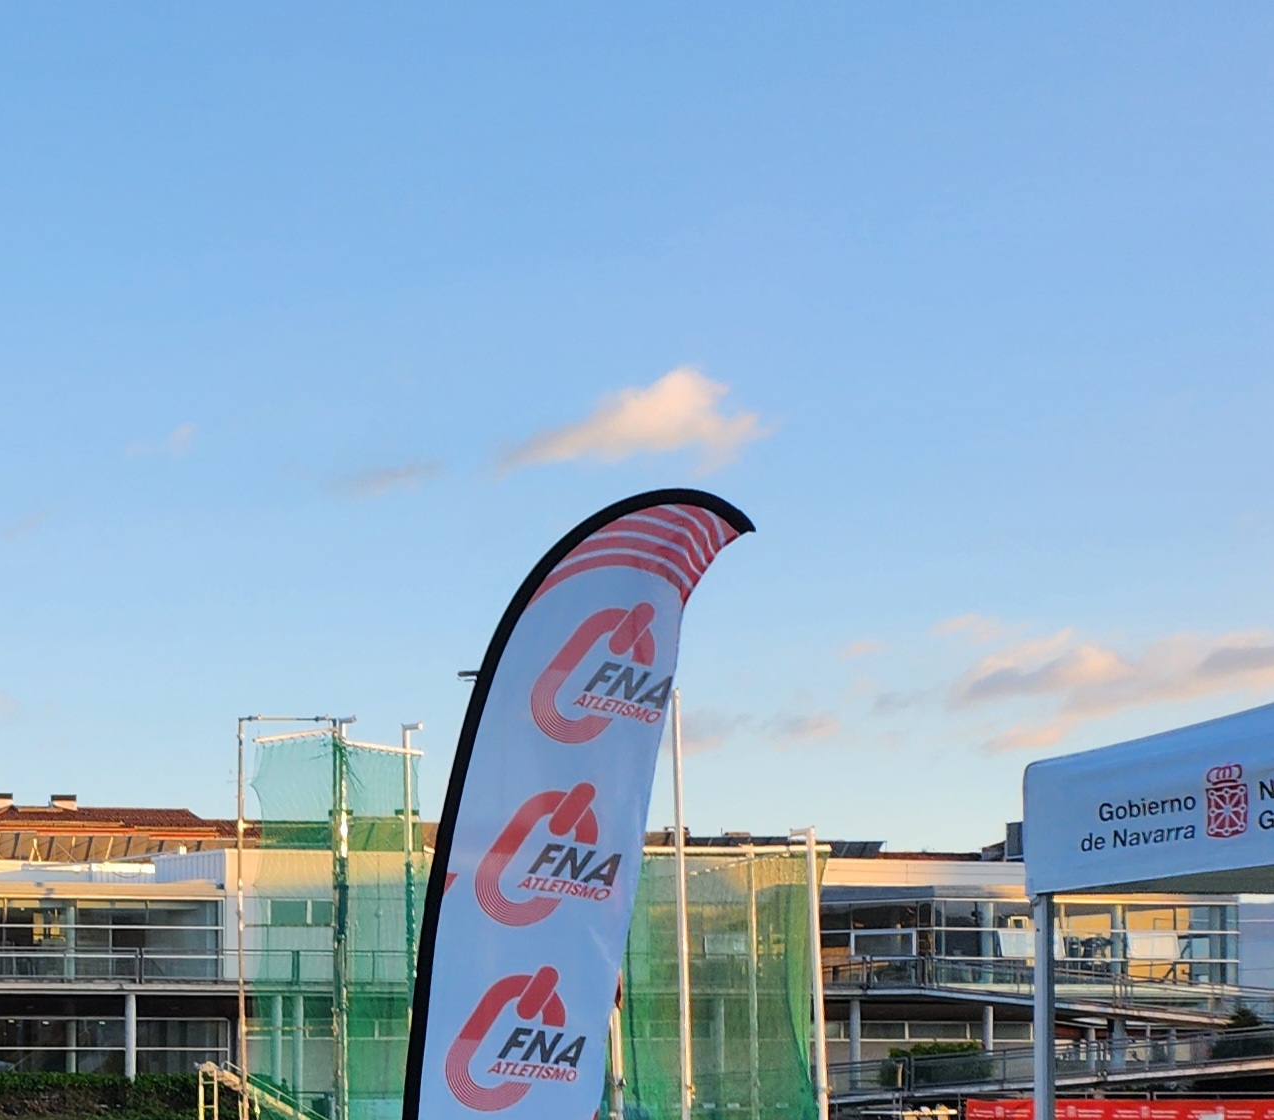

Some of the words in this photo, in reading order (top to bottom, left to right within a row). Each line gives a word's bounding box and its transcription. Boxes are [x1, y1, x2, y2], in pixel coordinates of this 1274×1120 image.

[583, 661, 673, 709] FNA
[573, 693, 661, 723] ATLETISMO
[1099, 796, 1196, 821] Gobierno
[1081, 833, 1105, 851] de
[1113, 825, 1195, 848] Navarra
[527, 843, 622, 886] FNA
[517, 876, 610, 901] ATLETISMO
[497, 1027, 586, 1068] FNA
[488, 1062, 577, 1082] ATLETISMO
